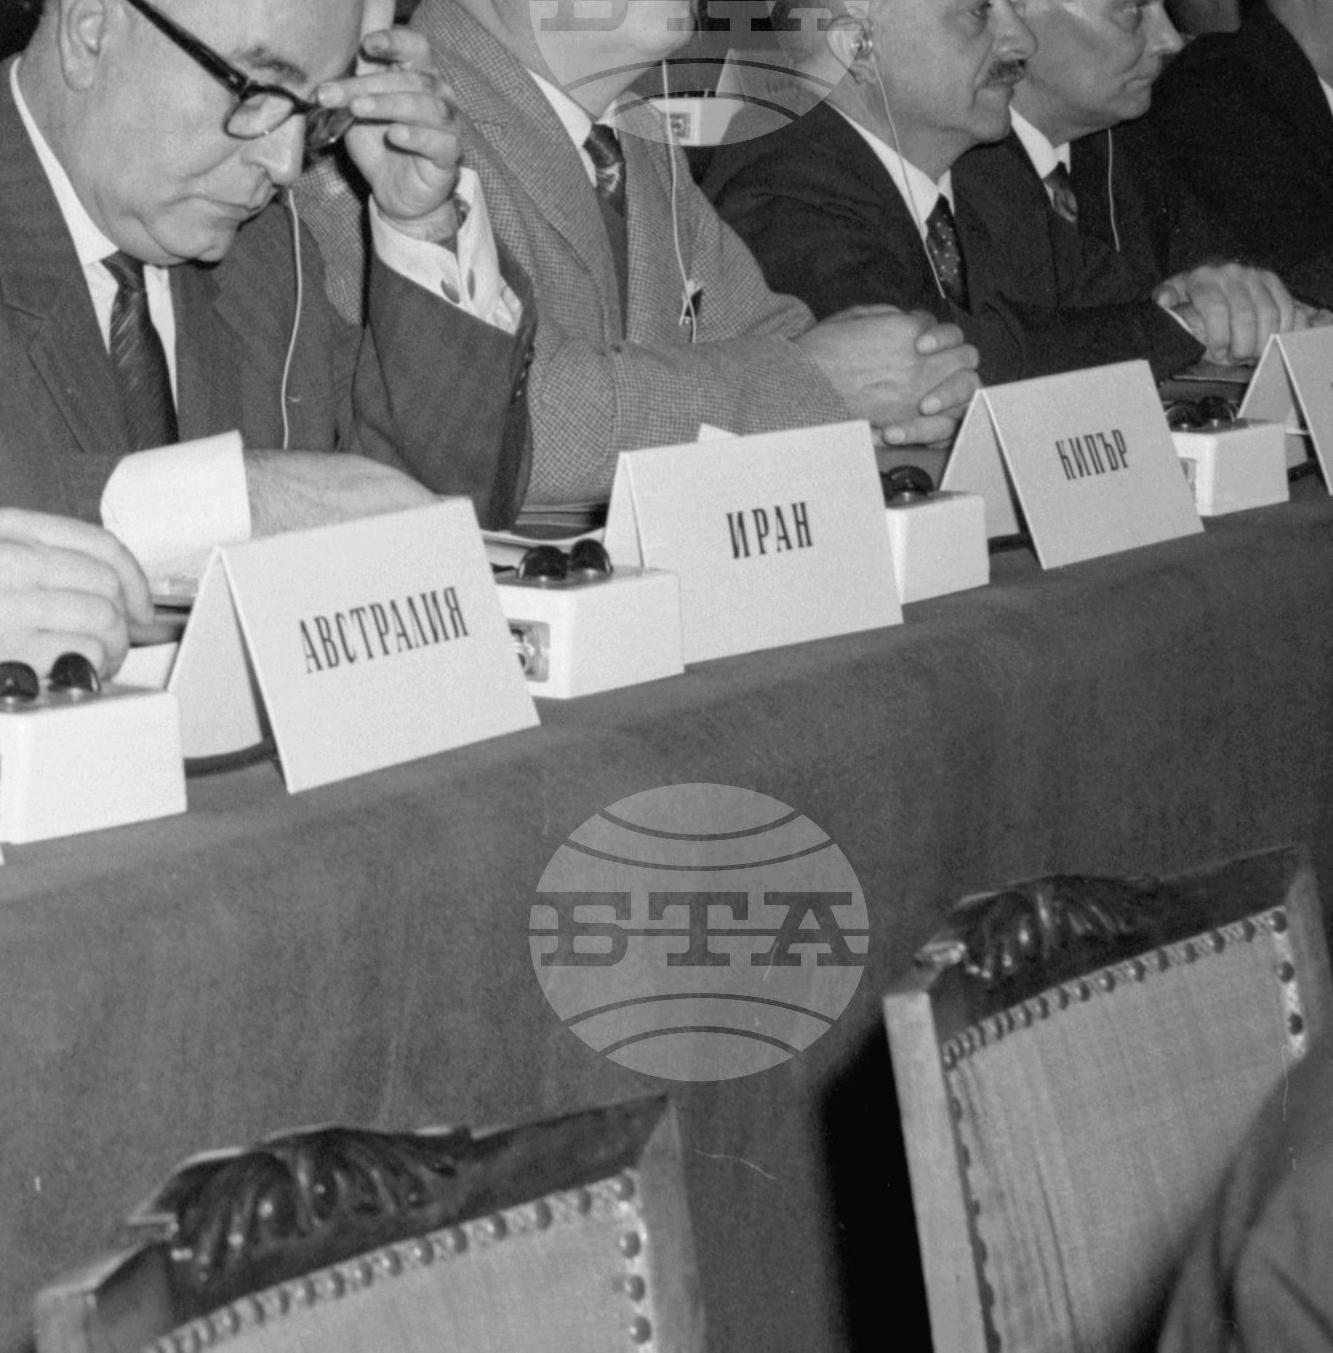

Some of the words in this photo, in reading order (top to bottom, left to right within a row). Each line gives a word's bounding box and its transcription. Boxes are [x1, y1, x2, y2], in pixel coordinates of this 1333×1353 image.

[1055, 429, 1129, 481] КИПЪР
[726, 501, 814, 560] ИРАН
[298, 586, 470, 675] АВСТРАЛИЯ
